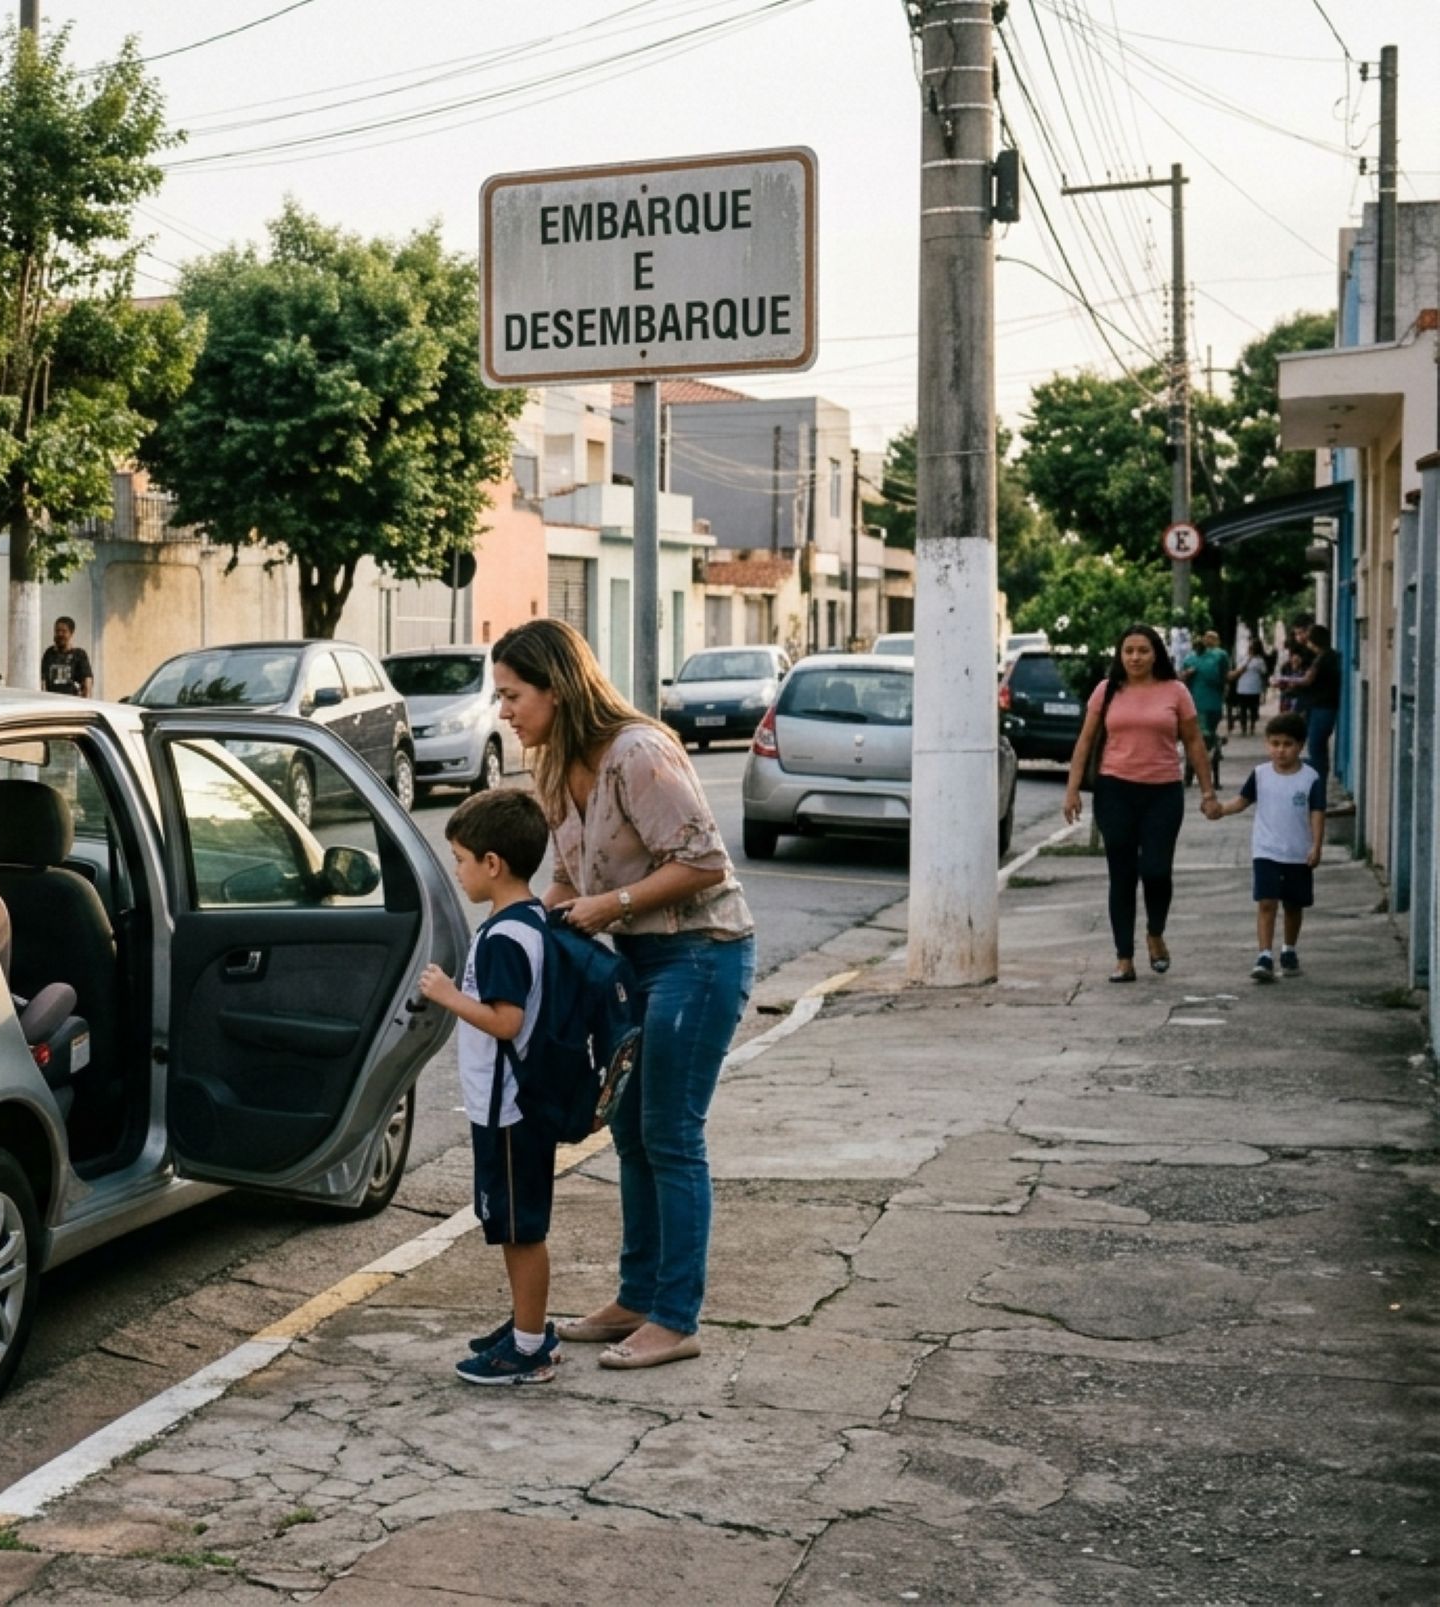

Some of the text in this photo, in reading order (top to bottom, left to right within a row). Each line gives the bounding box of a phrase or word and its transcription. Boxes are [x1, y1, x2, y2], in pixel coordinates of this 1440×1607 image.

[540, 189, 752, 245] EMBARQUE
[634, 251, 654, 290] E
[505, 295, 792, 352] DESEMBARQUE
[1175, 530, 1191, 552] E
